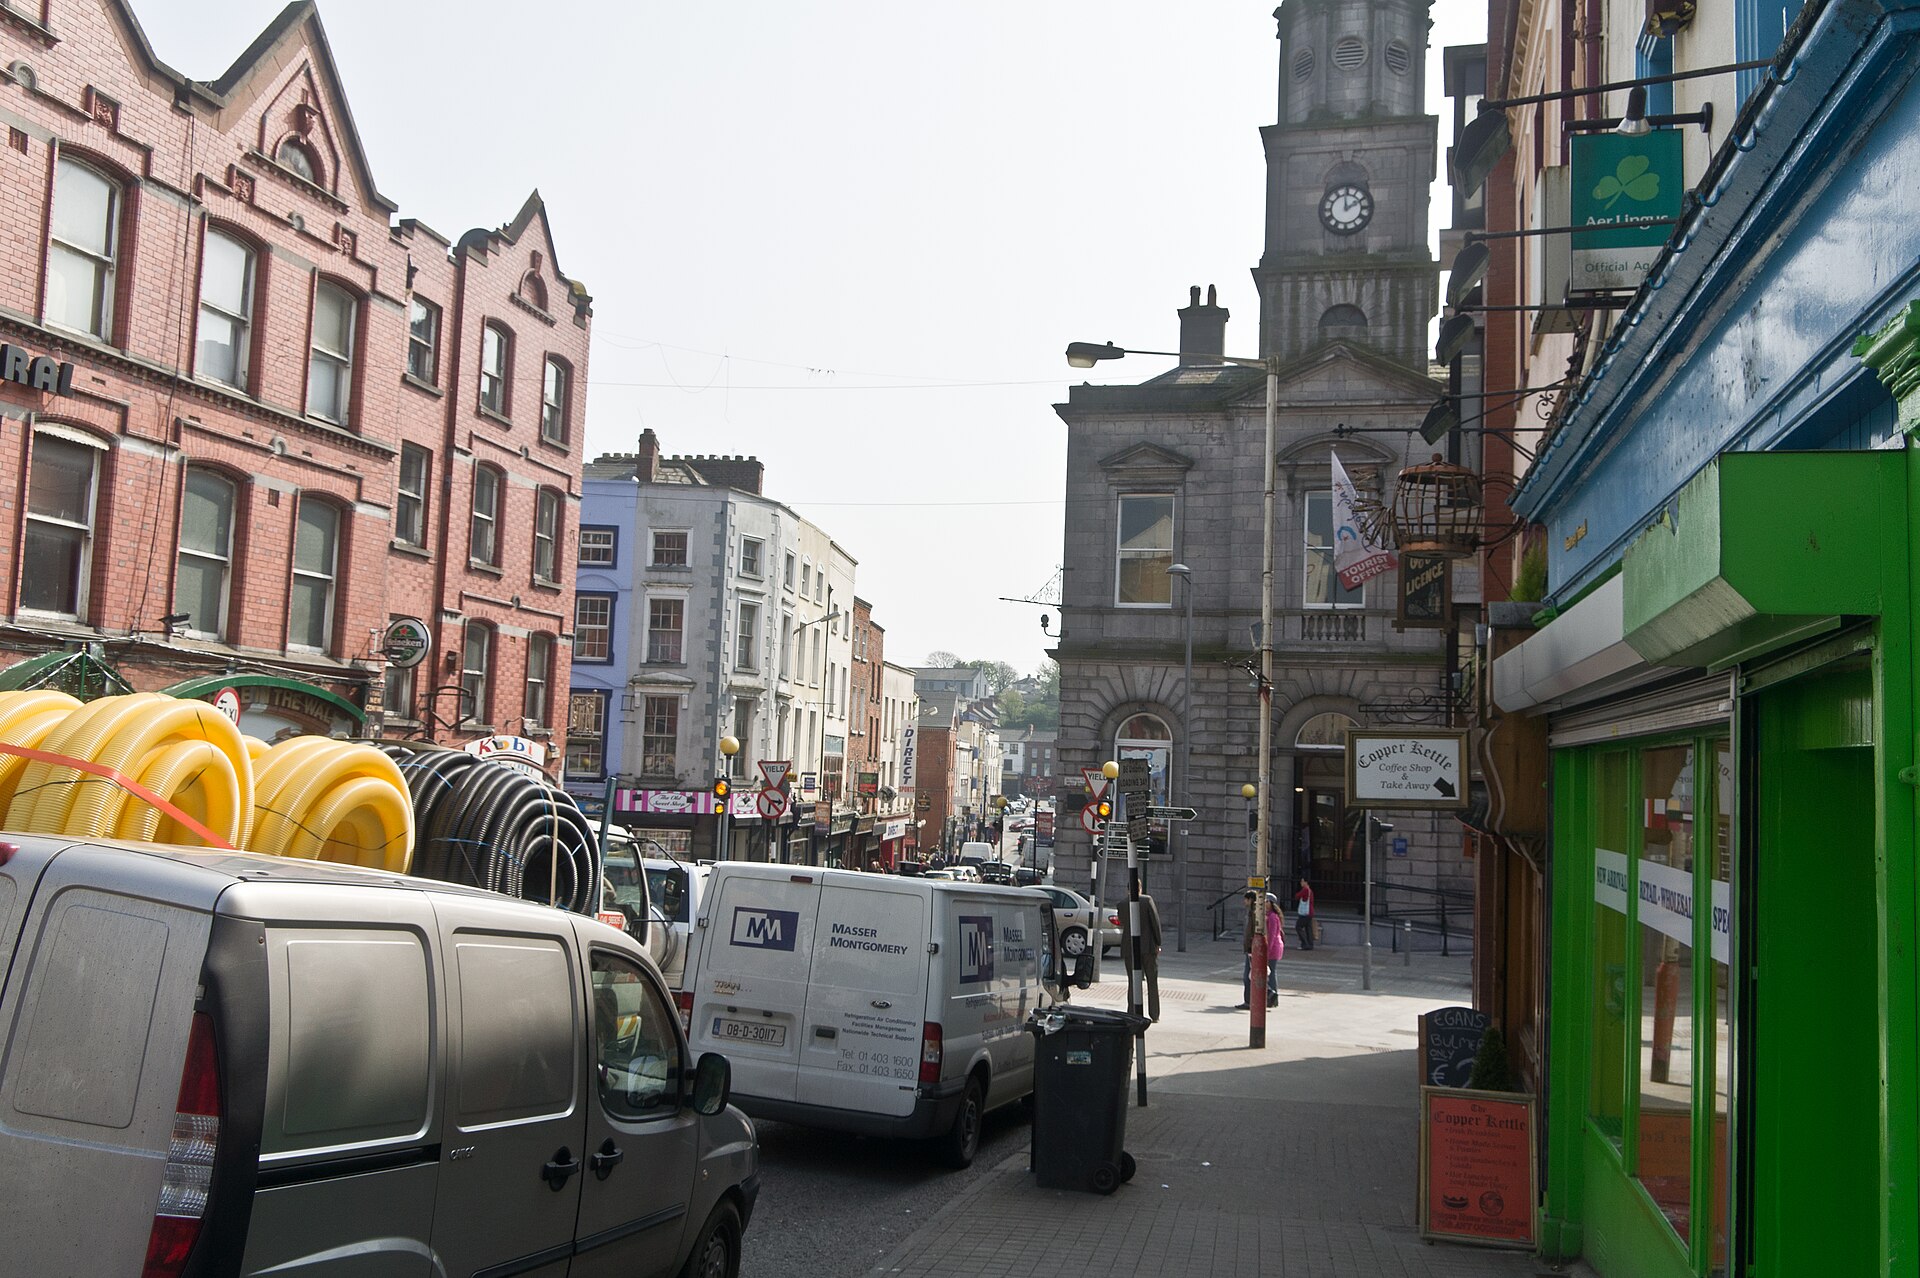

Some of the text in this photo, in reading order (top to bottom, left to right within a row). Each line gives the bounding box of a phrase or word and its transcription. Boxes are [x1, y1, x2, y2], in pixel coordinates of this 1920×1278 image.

[1585, 262, 1628, 273] Official
[1342, 555, 1388, 577] TOURIST
[1406, 561, 1444, 596] LICENCE
[903, 728, 915, 785] DIRECT
[1358, 740, 1452, 770] Copper Kettle
[764, 765, 785, 773] YIELD
[1379, 763, 1432, 774] Coffee Shop
[1401, 772, 1409, 780] &
[1380, 781, 1431, 791] Take Away
[1597, 866, 1607, 883] NEW
[1640, 880, 1657, 905] RETAIL
[832, 923, 877, 938] MASSER
[1003, 927, 1023, 943] MASSER
[830, 937, 908, 955] MONTGOMERY
[844, 1012, 875, 1021] Refrigeration
[885, 1018, 916, 1027] Conditioning
[1434, 1009, 1486, 1028] EGANS
[726, 1025, 777, 1041] 08-D-30117
[842, 1028, 915, 1042] Nationwide Technical Support
[852, 1021, 906, 1033] Facilities Management
[858, 1051, 868, 1060] 01
[871, 1053, 889, 1064] 403
[893, 1056, 913, 1067] 1600
[859, 1063, 869, 1074] 01
[872, 1066, 890, 1076] 403
[894, 1068, 914, 1080] 1650
[1471, 1104, 1487, 1113] The
[1434, 1111, 1526, 1131] Copper Kettle
